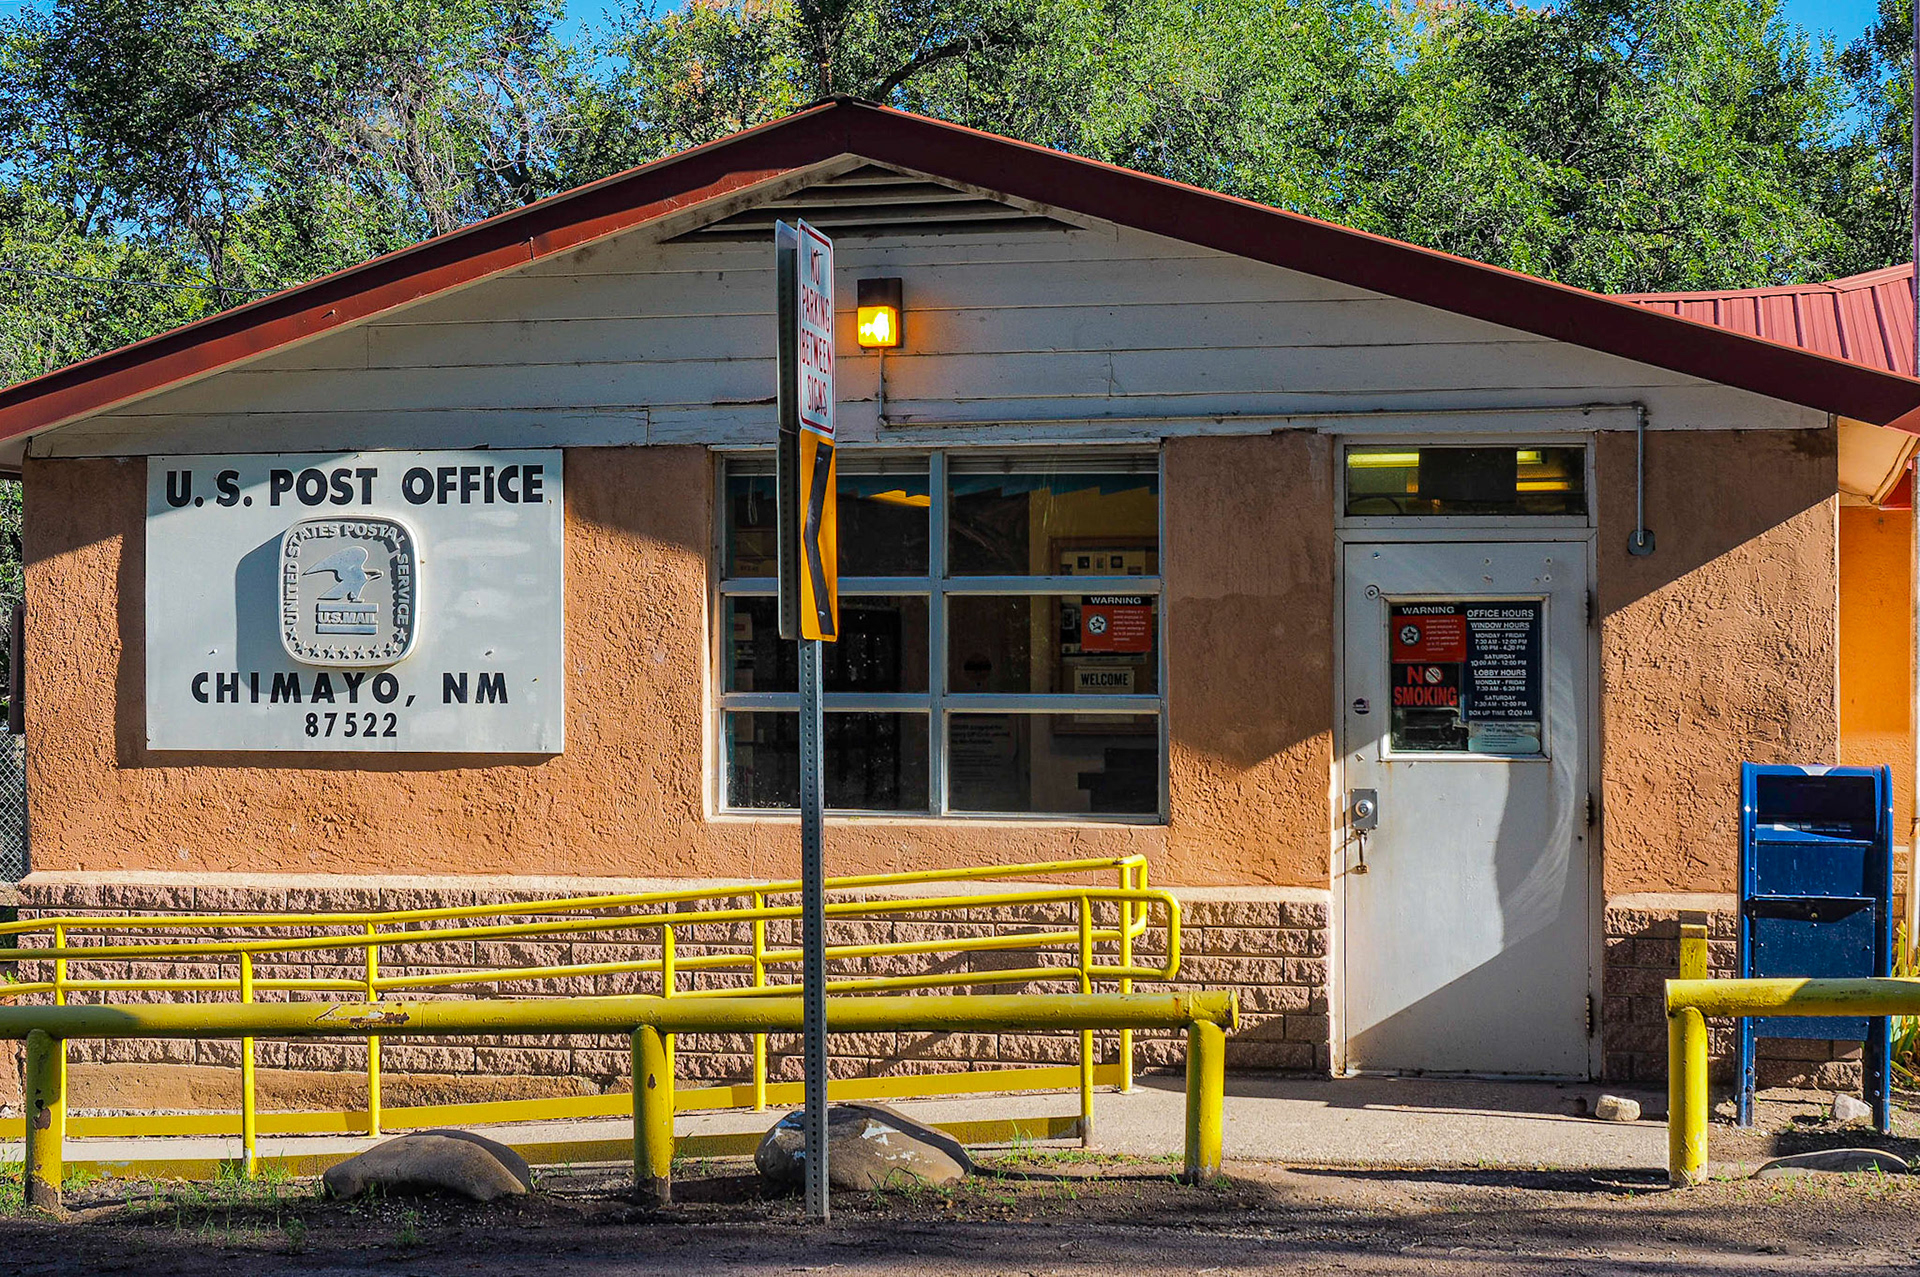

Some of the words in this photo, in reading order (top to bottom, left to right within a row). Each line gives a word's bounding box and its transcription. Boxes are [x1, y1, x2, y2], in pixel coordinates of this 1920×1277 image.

[810, 247, 820, 285] NO
[802, 284, 830, 333] PARKING
[802, 328, 832, 375] BETWEEN
[807, 375, 828, 417] SIGNS
[270, 467, 378, 506] POST
[402, 465, 544, 505] OFFICE
[286, 523, 339, 558] STATES
[343, 523, 405, 555] POSTAL
[283, 561, 299, 625] UNITED
[396, 553, 410, 625] SERVICE
[1091, 597, 1142, 605] WARNING
[1402, 606, 1455, 615] WARNING
[1467, 609, 1499, 618] OFFICE
[1501, 609, 1534, 618] HOURS
[191, 672, 416, 707] CHIMAYO,
[443, 672, 508, 704] NM
[1080, 673, 1128, 686] WELCOME
[1394, 686, 1457, 706] SMOKING
[305, 712, 398, 738] 87522
